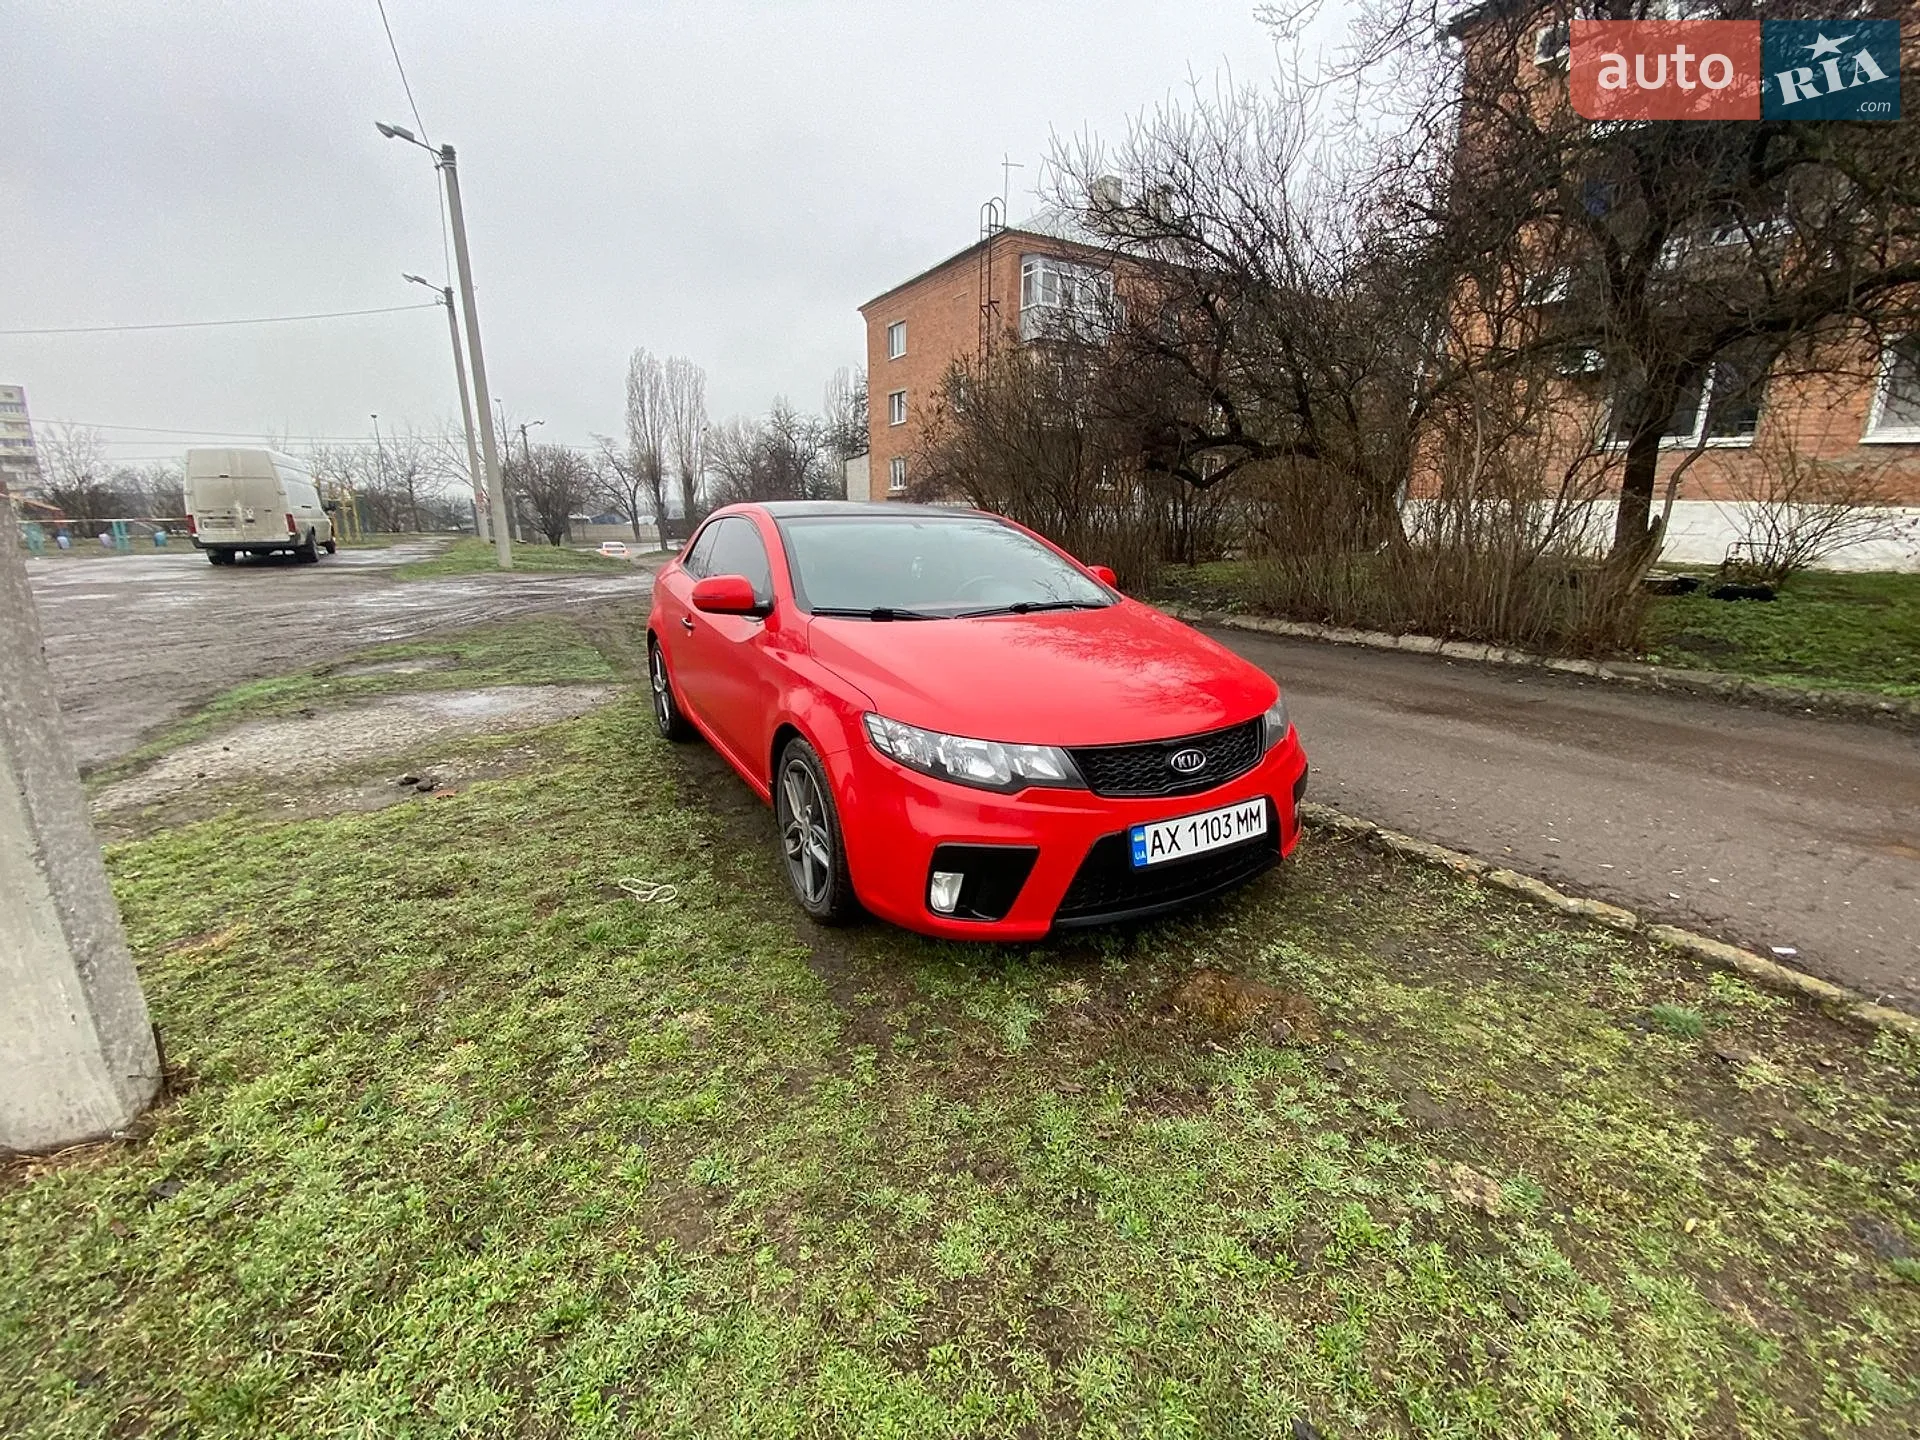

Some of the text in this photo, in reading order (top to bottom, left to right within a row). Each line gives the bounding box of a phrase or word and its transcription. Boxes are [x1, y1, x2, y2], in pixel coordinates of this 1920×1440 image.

[1177, 753, 1201, 768] KIA
[1150, 805, 1262, 857] AX 1103 MM
[1134, 849, 1147, 860] UA
